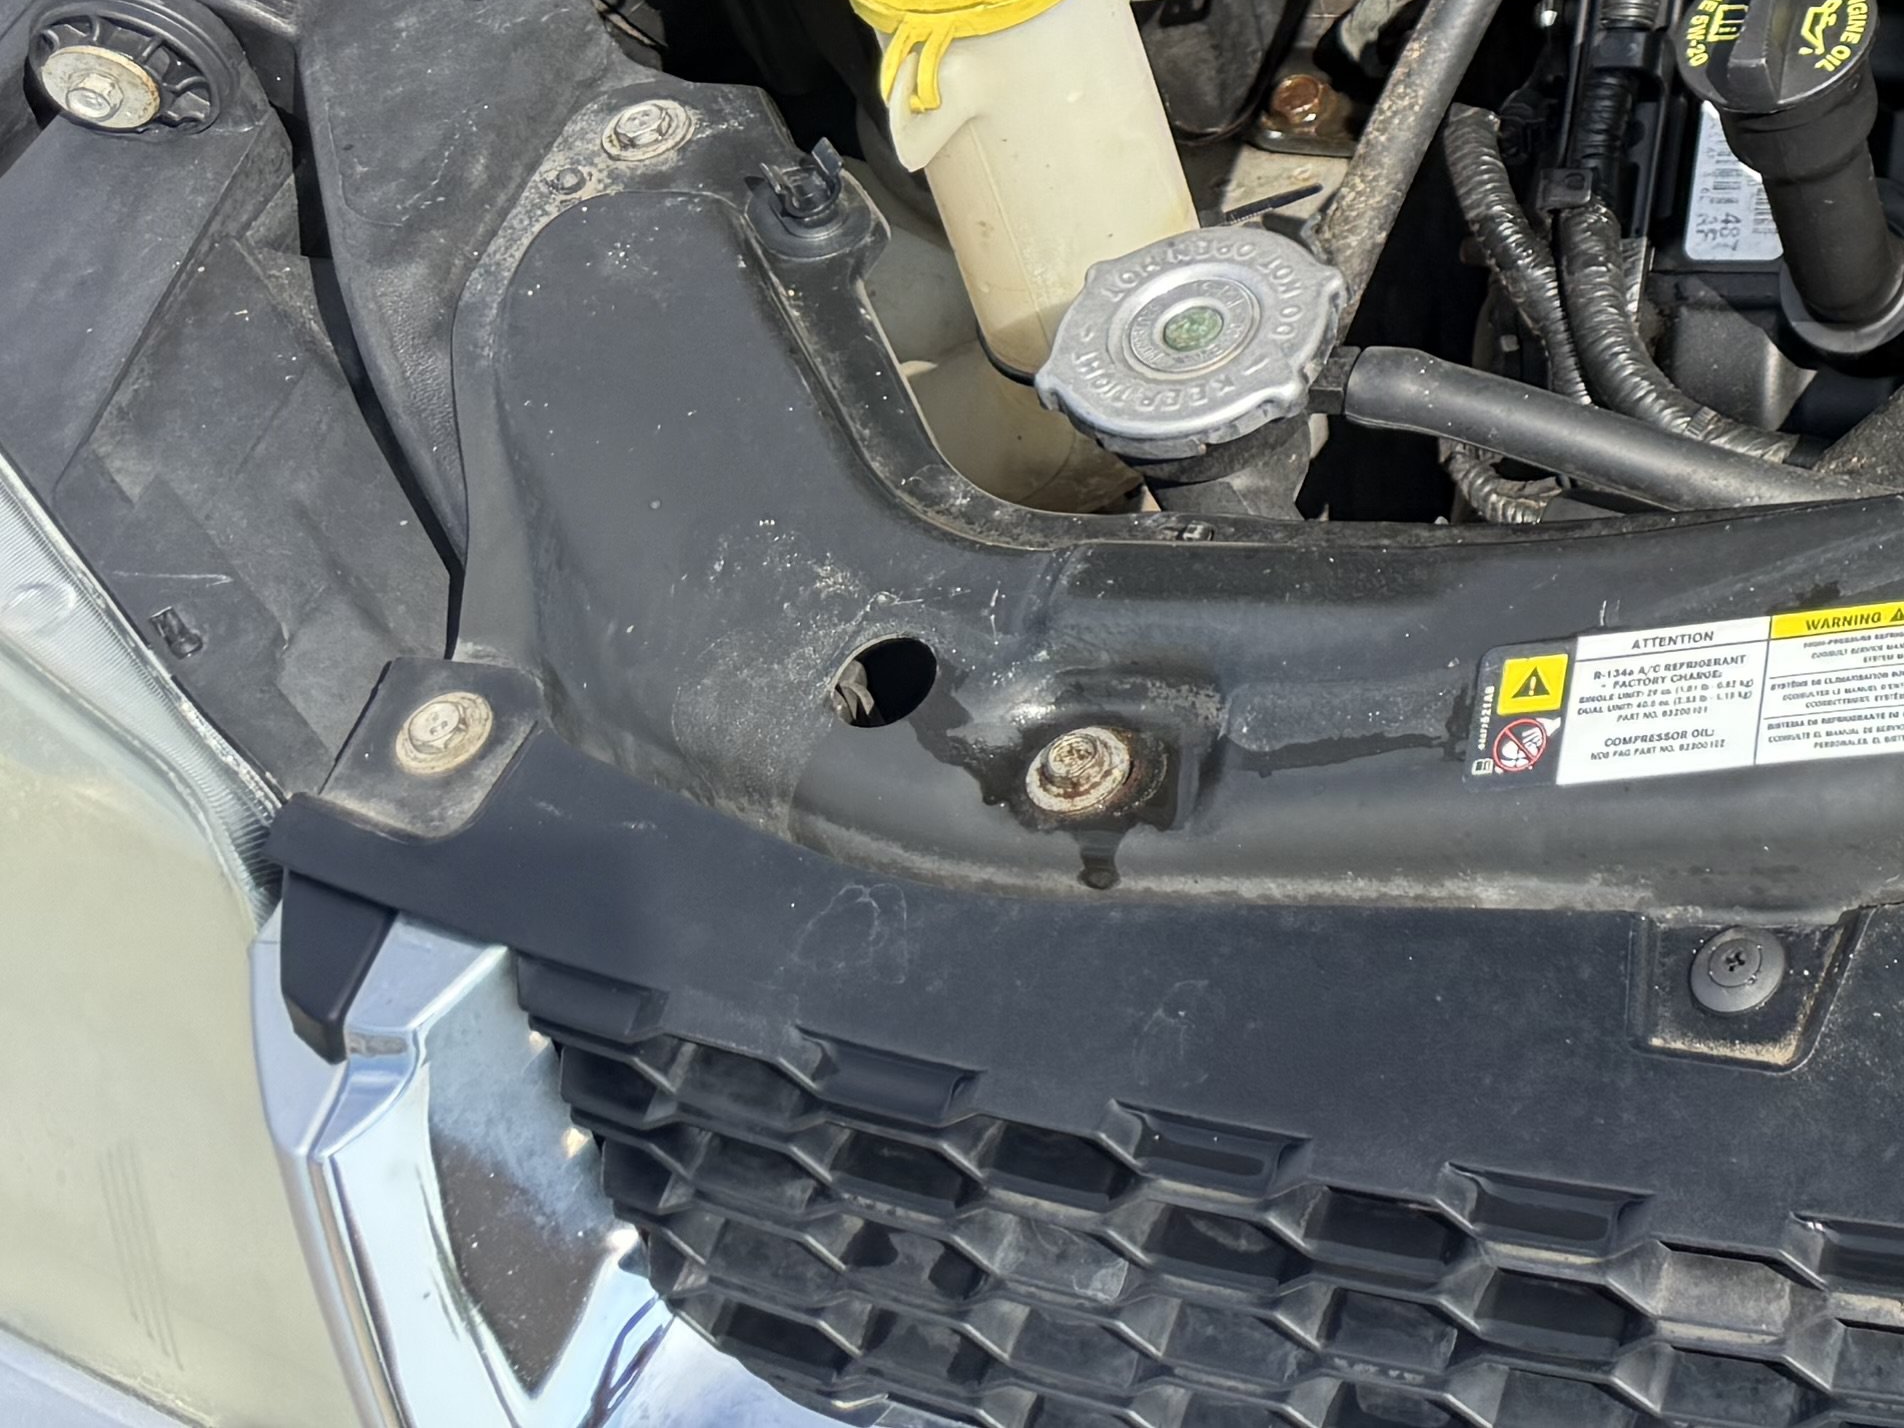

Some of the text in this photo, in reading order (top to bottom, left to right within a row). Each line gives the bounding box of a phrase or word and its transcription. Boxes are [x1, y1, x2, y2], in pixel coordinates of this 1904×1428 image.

[1686, 15, 1710, 66] 5W-20
[1815, 44, 1851, 73] OIL
[1805, 610, 1882, 631] WARNING
[1631, 630, 1714, 650] ATTENTION
[1663, 654, 1746, 672] REFRIGERANT
[1612, 675, 1667, 689] FACTORY
[1603, 729, 1687, 747] COMPRESSOR
